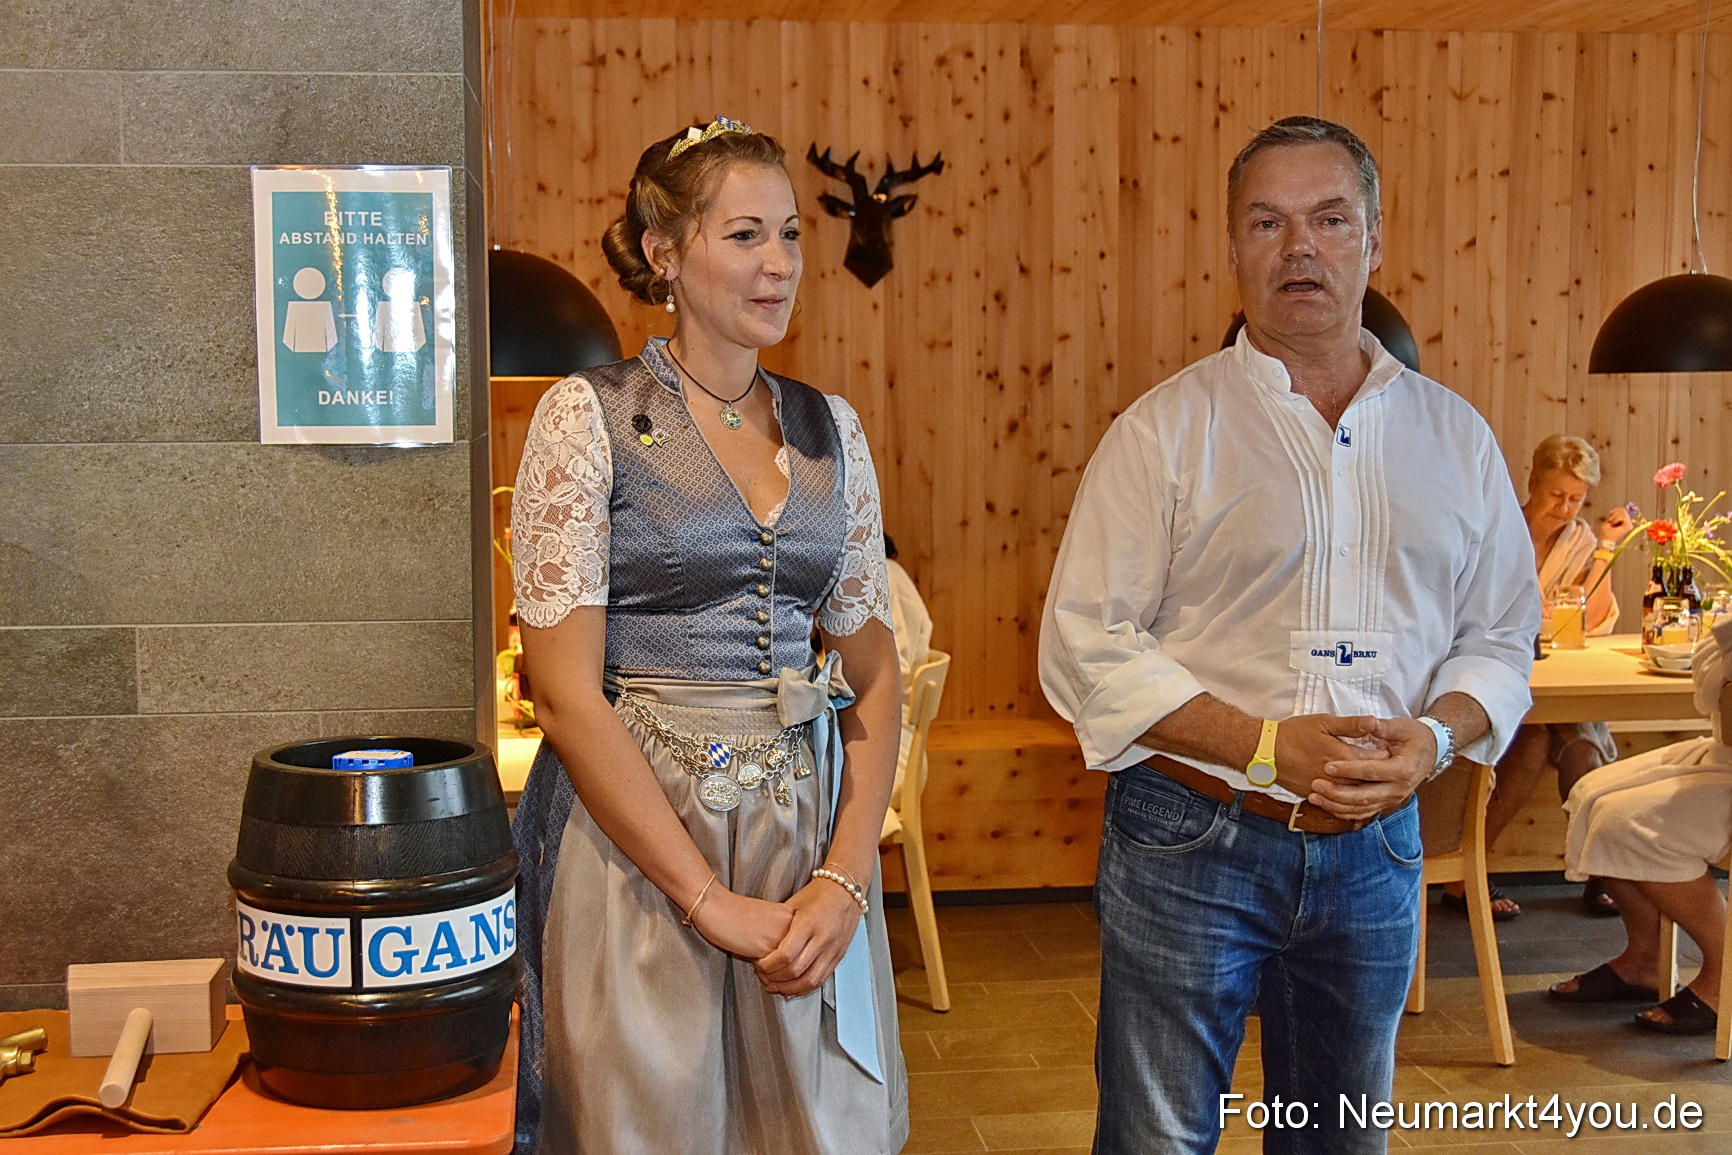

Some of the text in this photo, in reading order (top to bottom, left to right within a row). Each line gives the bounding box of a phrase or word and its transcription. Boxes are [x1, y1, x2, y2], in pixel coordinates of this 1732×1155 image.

[279, 232, 428, 245] ABSTAND HALTEN
[318, 390, 394, 405] DANKE!
[1311, 649, 1336, 657] GANS
[1141, 801, 1180, 821] LEGEND
[368, 897, 515, 979] GANS
